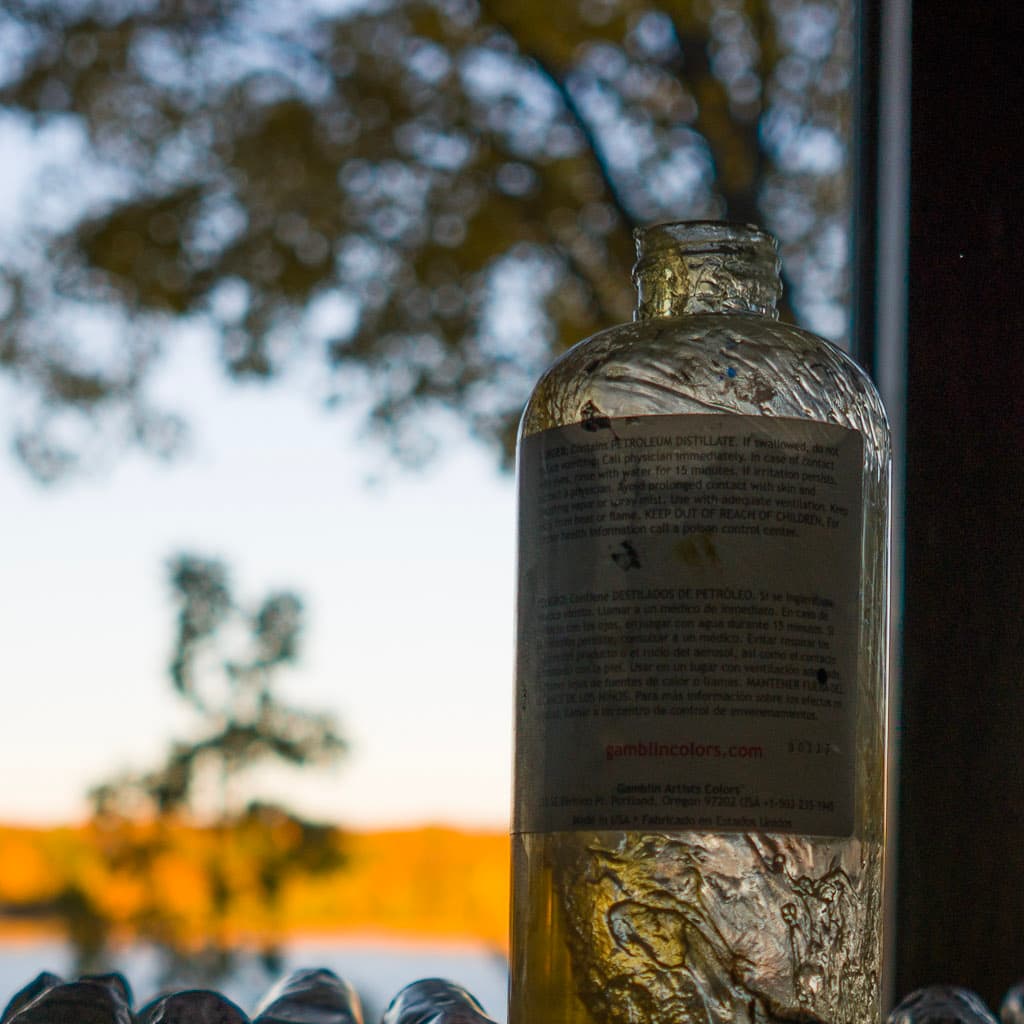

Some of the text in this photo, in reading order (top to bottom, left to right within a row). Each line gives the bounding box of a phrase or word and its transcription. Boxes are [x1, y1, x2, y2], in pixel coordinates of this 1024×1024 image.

[674, 509, 697, 519] OUT
[759, 511, 773, 521] OF
[607, 741, 762, 760] gamblincolors.com
